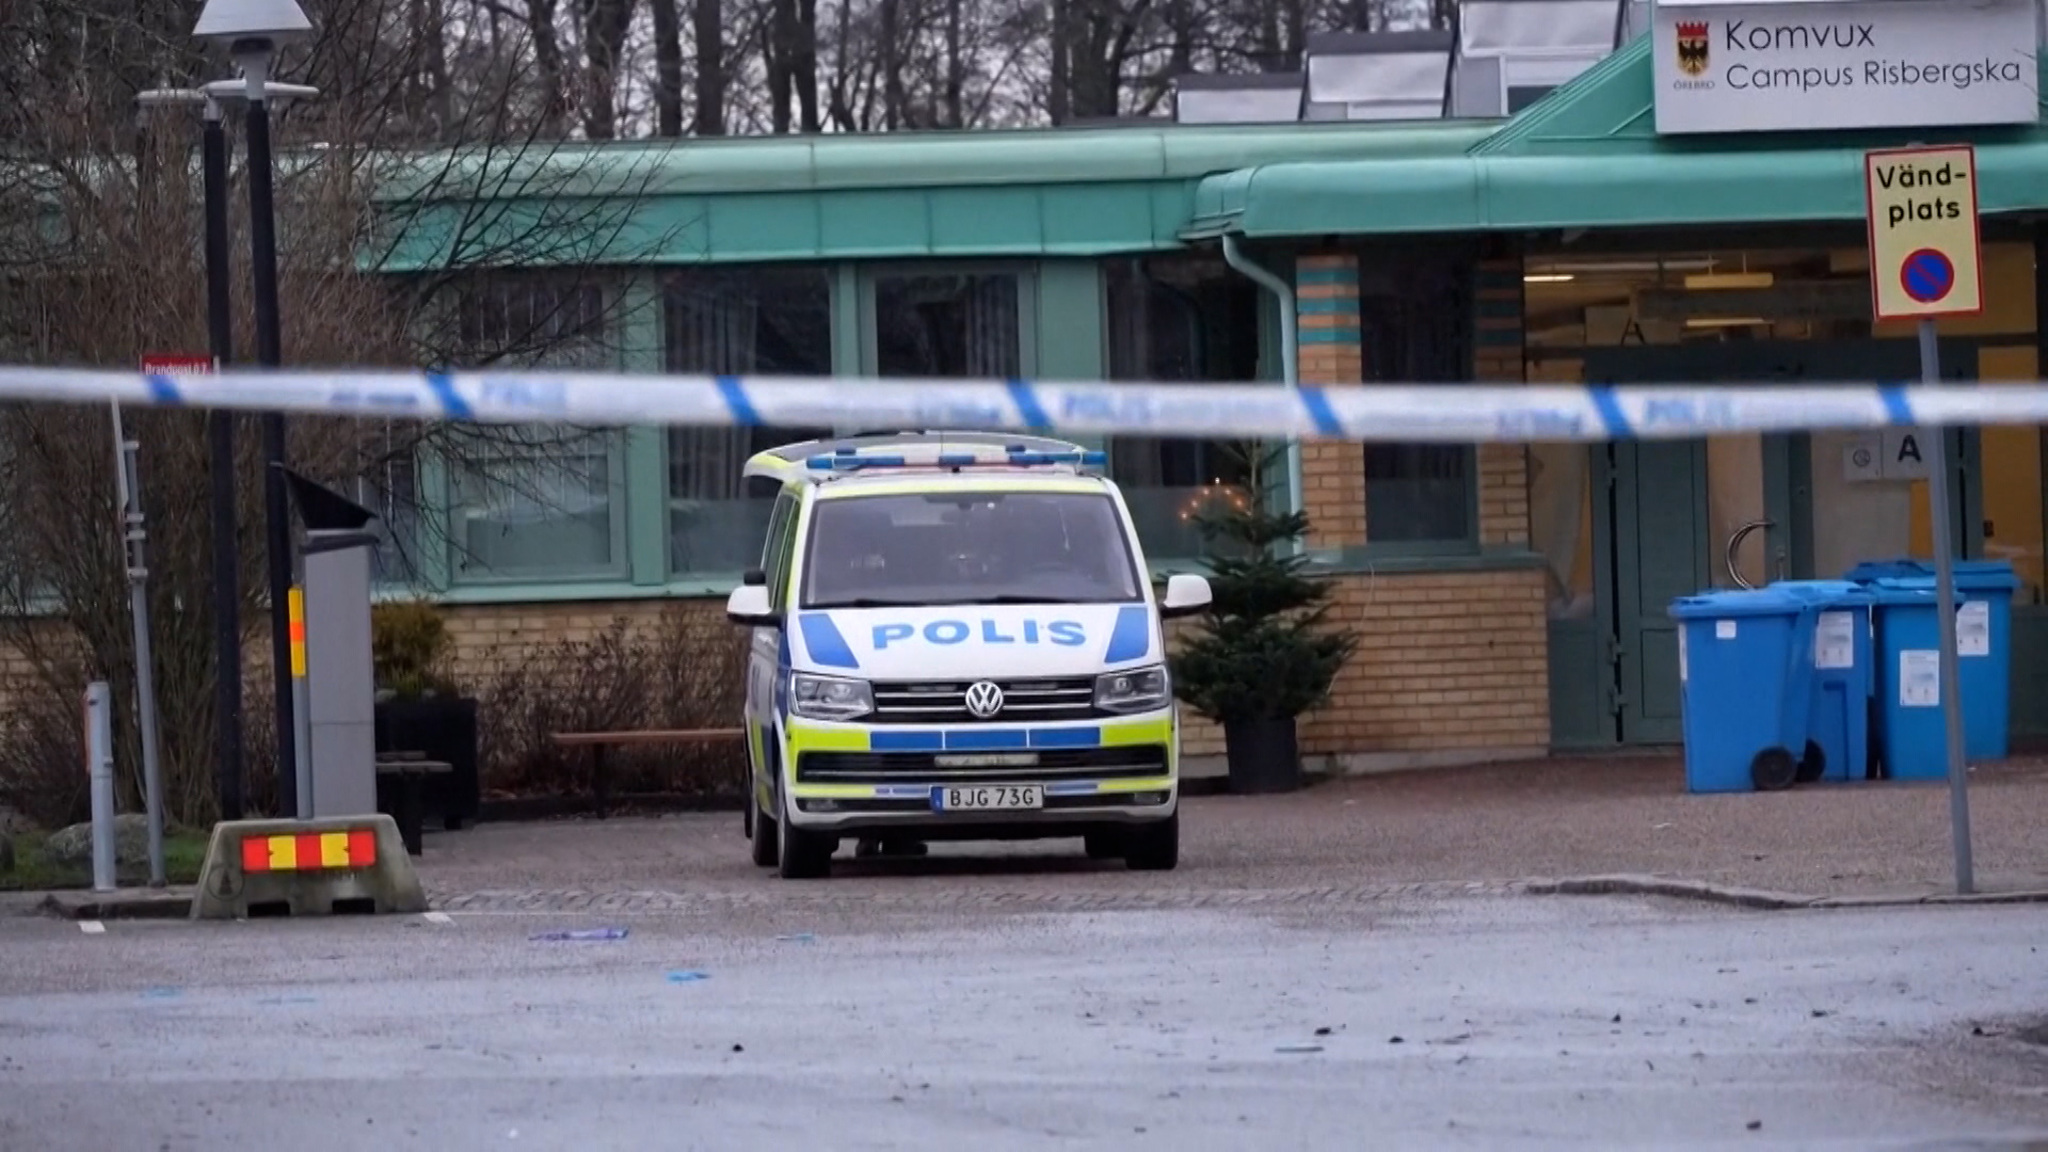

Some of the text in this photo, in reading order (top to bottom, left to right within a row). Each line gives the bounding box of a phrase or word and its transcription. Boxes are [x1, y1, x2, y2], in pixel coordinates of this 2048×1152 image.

[1726, 19, 1875, 51] Komvux
[1726, 57, 2020, 93] Campus Risbergska
[1876, 161, 1966, 190] Vänd-
[1889, 197, 1960, 228] plats
[1897, 434, 1922, 462] A
[872, 619, 1087, 650] POLIS
[950, 788, 1034, 806] BJG 73G
